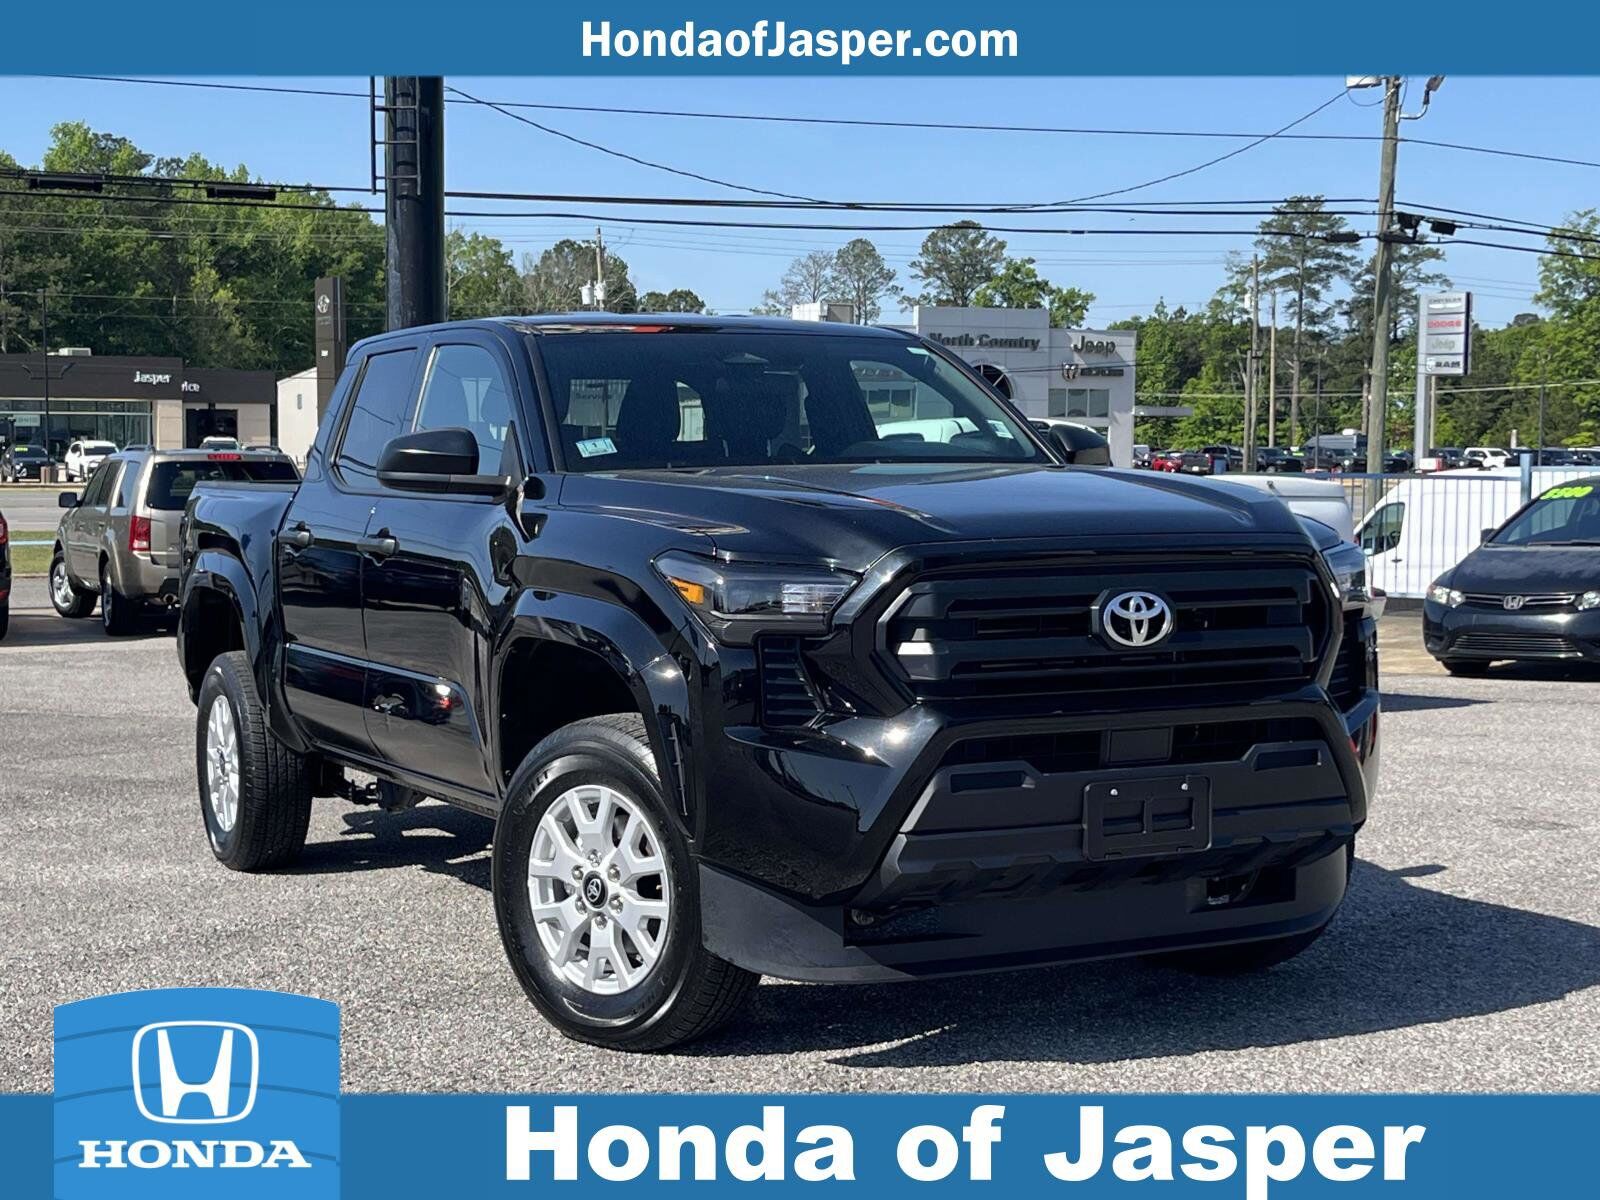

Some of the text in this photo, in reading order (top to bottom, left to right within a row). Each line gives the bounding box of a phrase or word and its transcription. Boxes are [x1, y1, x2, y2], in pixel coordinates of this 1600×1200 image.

[929, 333, 1041, 350] North Country
[1073, 335, 1116, 356] Jeep
[134, 371, 171, 384] Jasper
